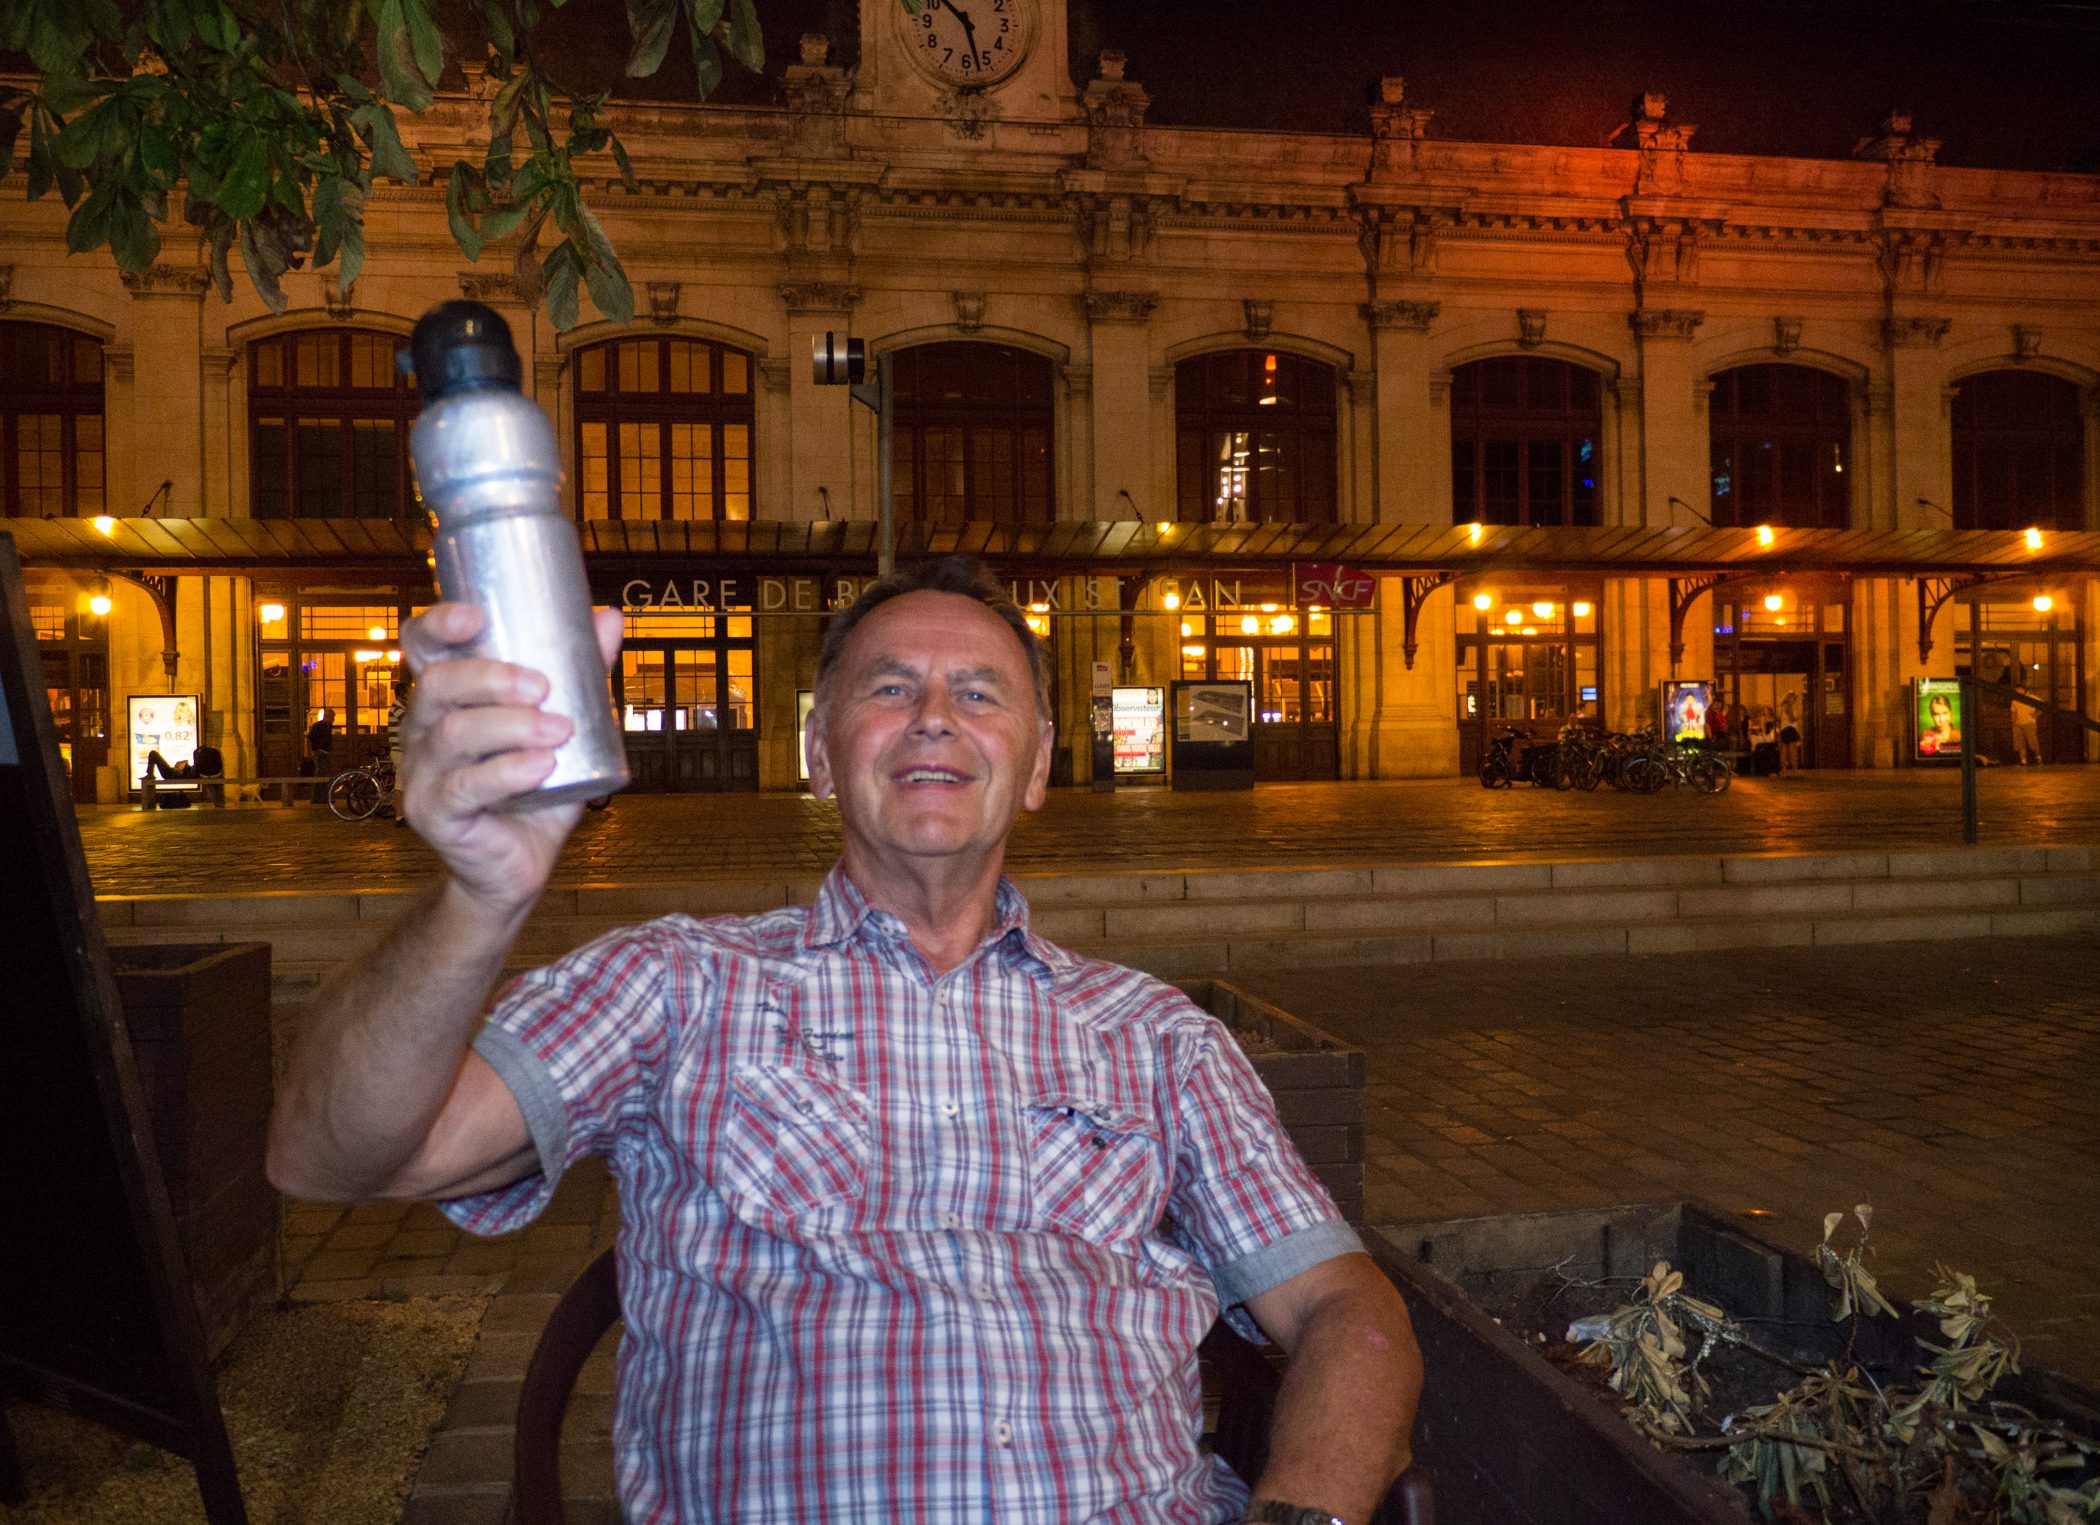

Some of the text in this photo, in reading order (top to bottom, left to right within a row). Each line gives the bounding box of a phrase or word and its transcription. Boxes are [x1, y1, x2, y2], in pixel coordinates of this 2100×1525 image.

[994, 0, 1004, 12] 2
[922, 14, 932, 28] 9
[1000, 19, 1009, 33] 3
[927, 34, 937, 48] 8
[994, 36, 1003, 50] 4
[943, 48, 953, 63] 7
[961, 55, 971, 69] 6
[982, 51, 991, 65] 5
[1299, 565, 1372, 602] SNCF
[622, 579, 737, 611] GARE
[763, 579, 812, 610] DE
[1086, 580, 1125, 610] ST
[1146, 579, 1241, 611] JAN
